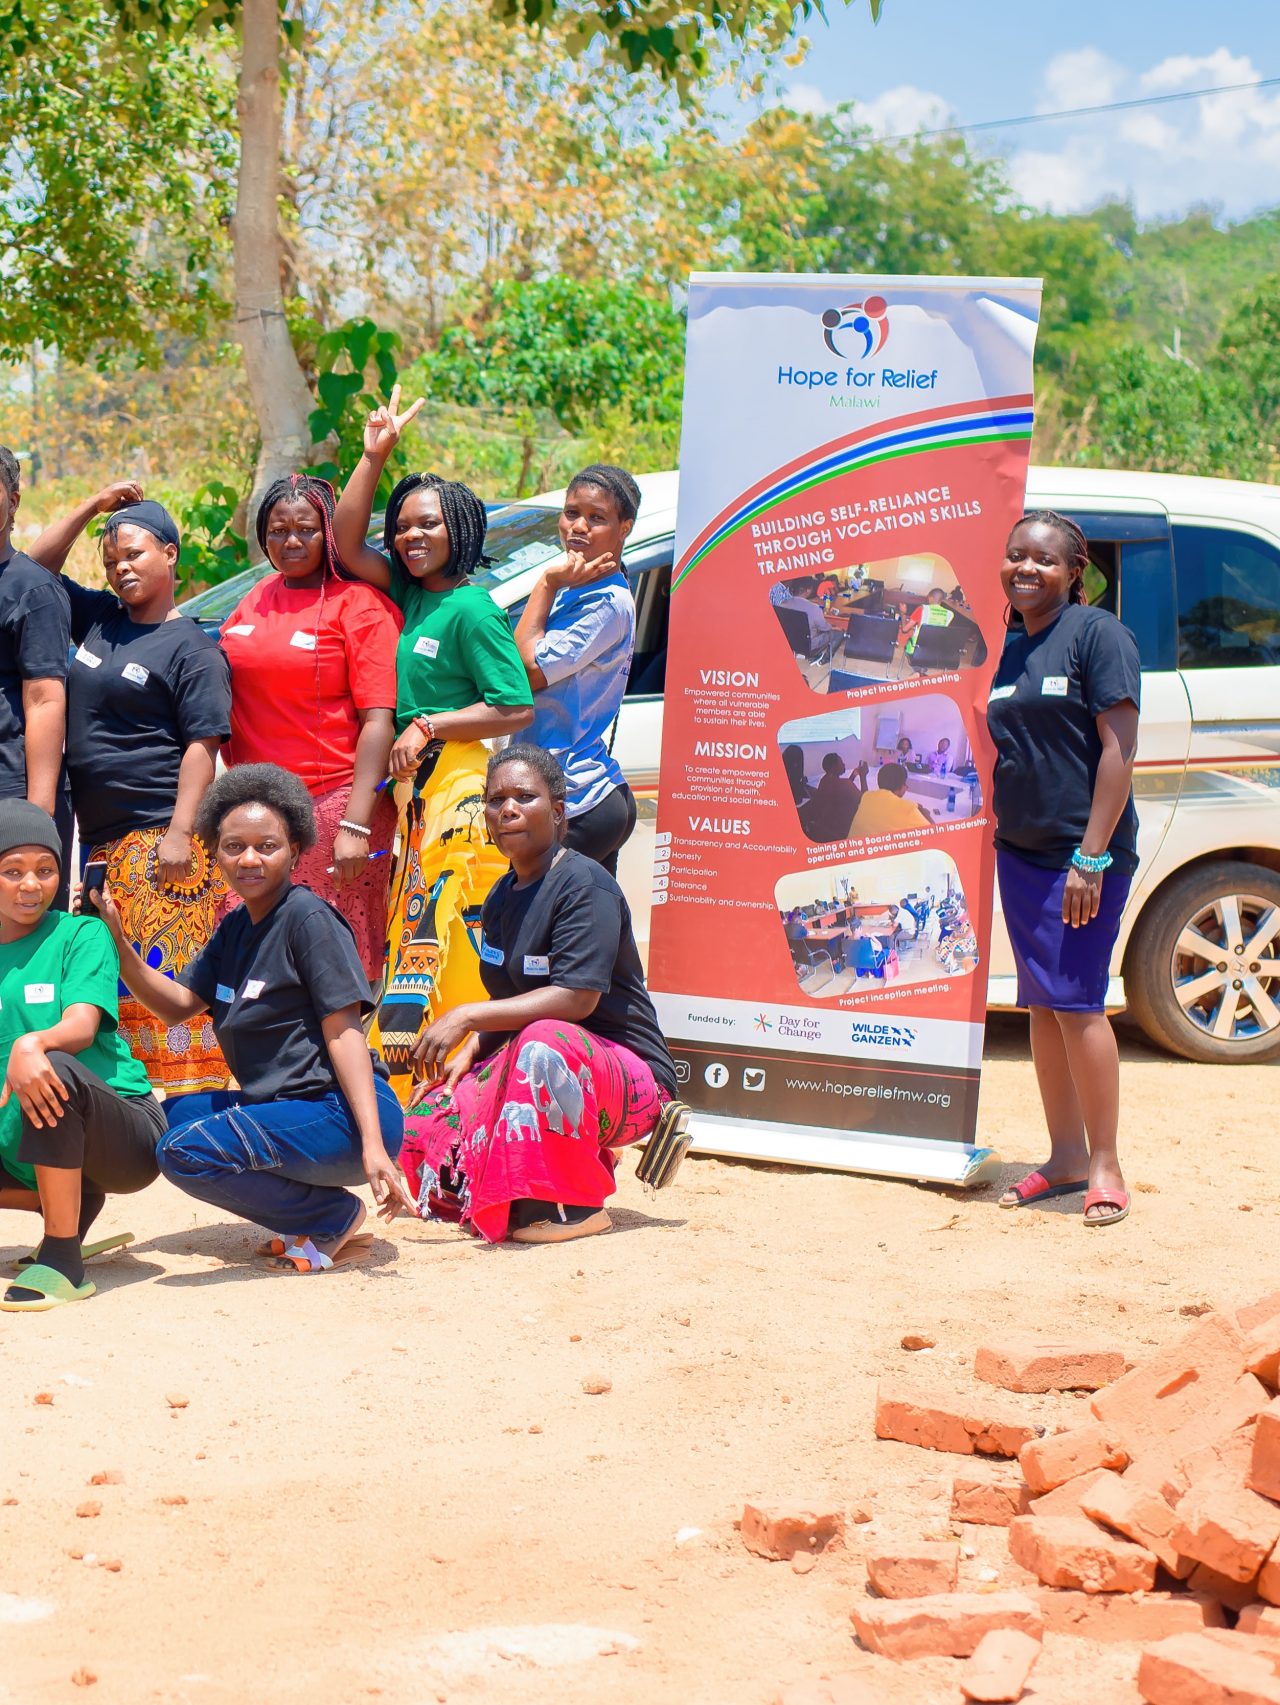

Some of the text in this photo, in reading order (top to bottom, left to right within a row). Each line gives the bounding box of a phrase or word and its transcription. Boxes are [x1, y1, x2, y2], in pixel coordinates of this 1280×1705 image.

[778, 367, 937, 389] Hope for Relief
[829, 395, 880, 408] Malawi
[751, 486, 951, 538] BUILDING SELF-RELIANCE
[754, 501, 982, 557] THROUGH VOCATION SKILLS
[758, 548, 835, 575] TRAINING
[700, 670, 759, 687] VISION
[847, 687, 876, 699] Project
[922, 673, 961, 685] meeting.
[684, 688, 780, 700] Empowered communities
[696, 707, 731, 716] members
[729, 701, 769, 709] vulnerable
[730, 718, 747, 726] their
[749, 719, 766, 727] lives.
[695, 741, 767, 760] MISSION
[695, 766, 720, 774] create
[722, 769, 769, 777] empowered
[687, 775, 765, 787] communities through
[690, 784, 722, 793] provision
[672, 792, 710, 801] education
[730, 796, 751, 804] social
[689, 816, 751, 835] VALUES
[673, 837, 723, 848] Transparency
[743, 843, 797, 855] Accountability
[806, 843, 837, 855] Training
[839, 841, 847, 849] of
[849, 839, 863, 848] the
[865, 834, 891, 845] Board
[893, 827, 934, 840] members
[936, 825, 944, 833] in
[672, 852, 701, 861] Honesty
[808, 851, 845, 864] operation
[848, 846, 865, 857] and
[671, 866, 717, 877] Participation
[671, 880, 707, 891] Tolerance
[669, 894, 716, 904] Sustainability
[736, 901, 775, 910] ownership.
[839, 996, 868, 1006] Project
[914, 984, 951, 996] meeting.
[688, 1013, 736, 1026] Funded by:
[779, 1016, 820, 1028] Day for
[778, 1026, 821, 1040] Change
[853, 1023, 889, 1034] WILDE
[852, 1034, 900, 1046] GANZEN
[785, 1078, 951, 1108] www.hopereliefmw.org
